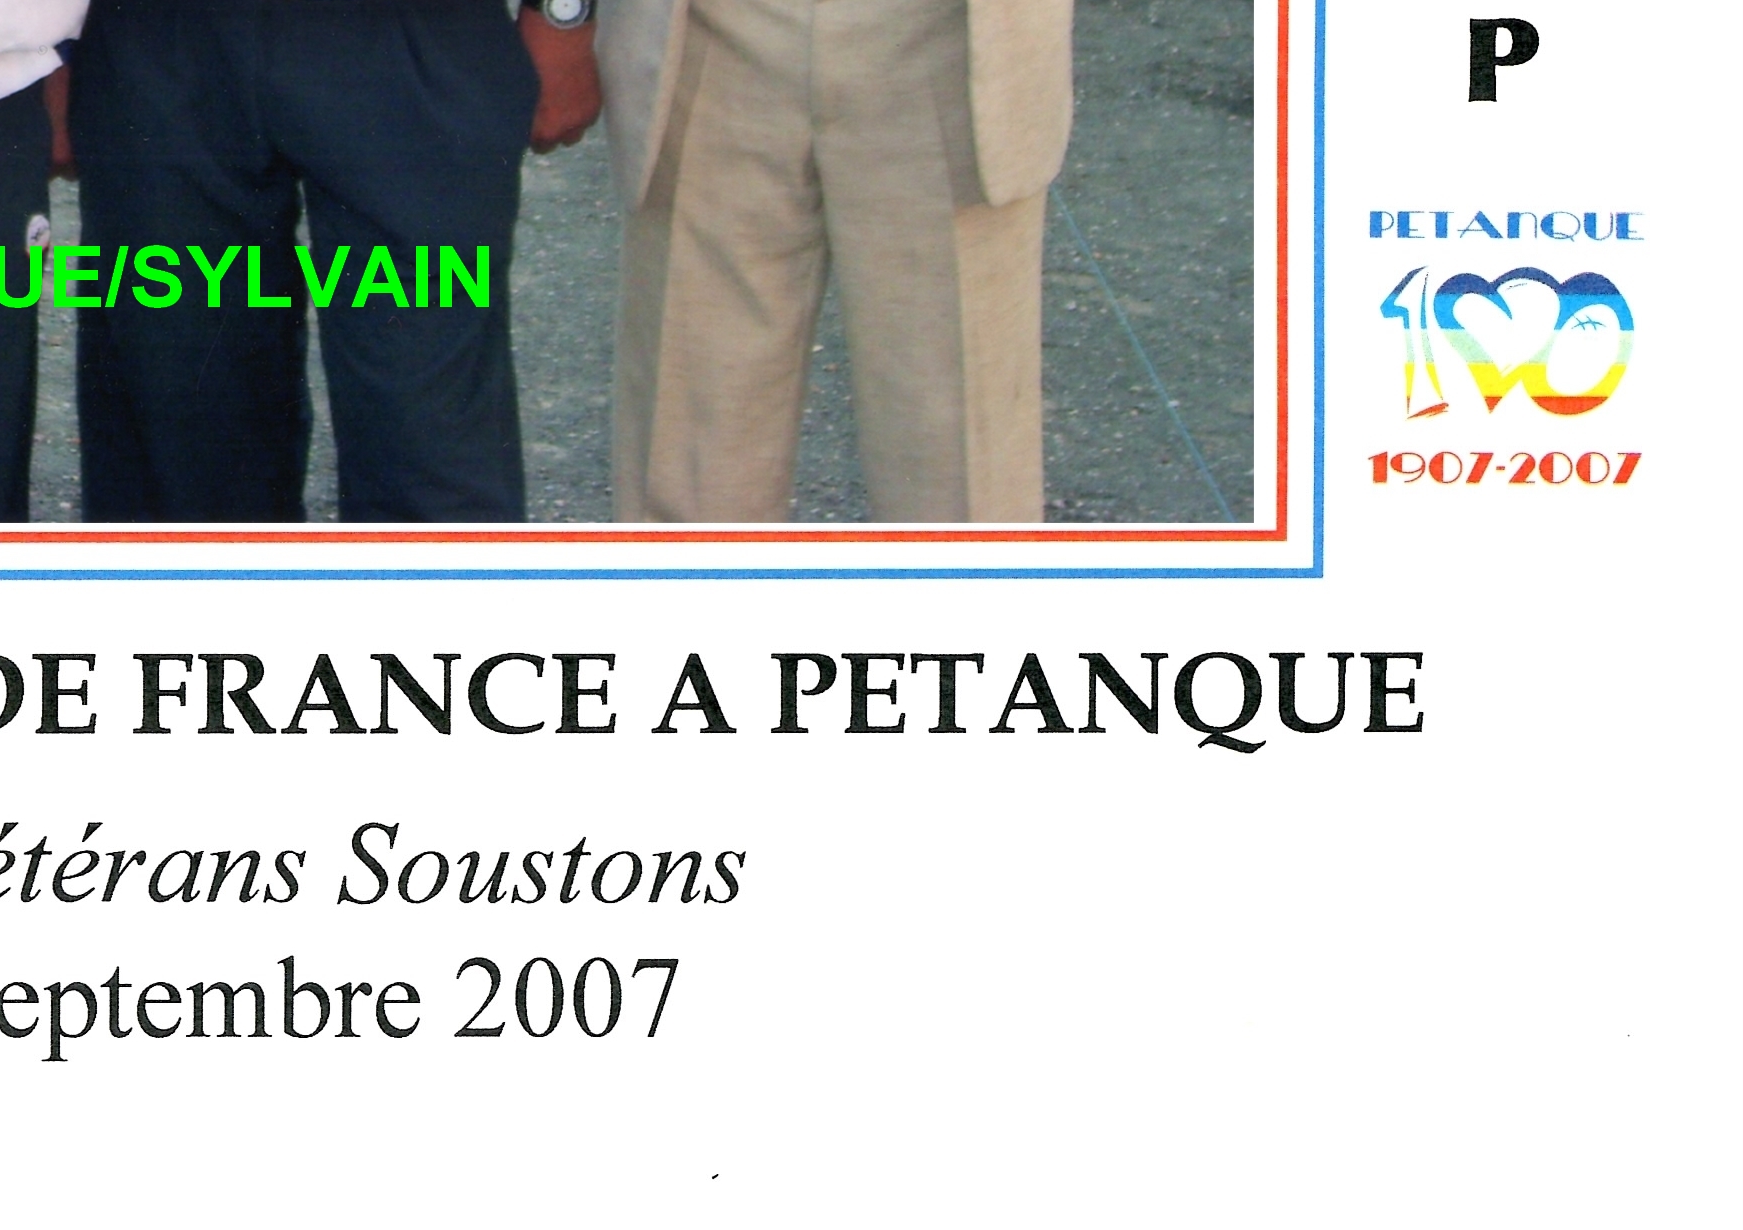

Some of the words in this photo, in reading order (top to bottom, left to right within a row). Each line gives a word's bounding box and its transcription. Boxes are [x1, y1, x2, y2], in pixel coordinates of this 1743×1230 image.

[1369, 210, 1645, 242] PETANQUE
[1367, 452, 1643, 484] 1907-2007
[132, 652, 617, 736] FRANCE
[650, 652, 738, 734] A
[770, 651, 1425, 754] PETANQUE
[336, 821, 747, 905] Soustons
[453, 956, 679, 1038] 2007
